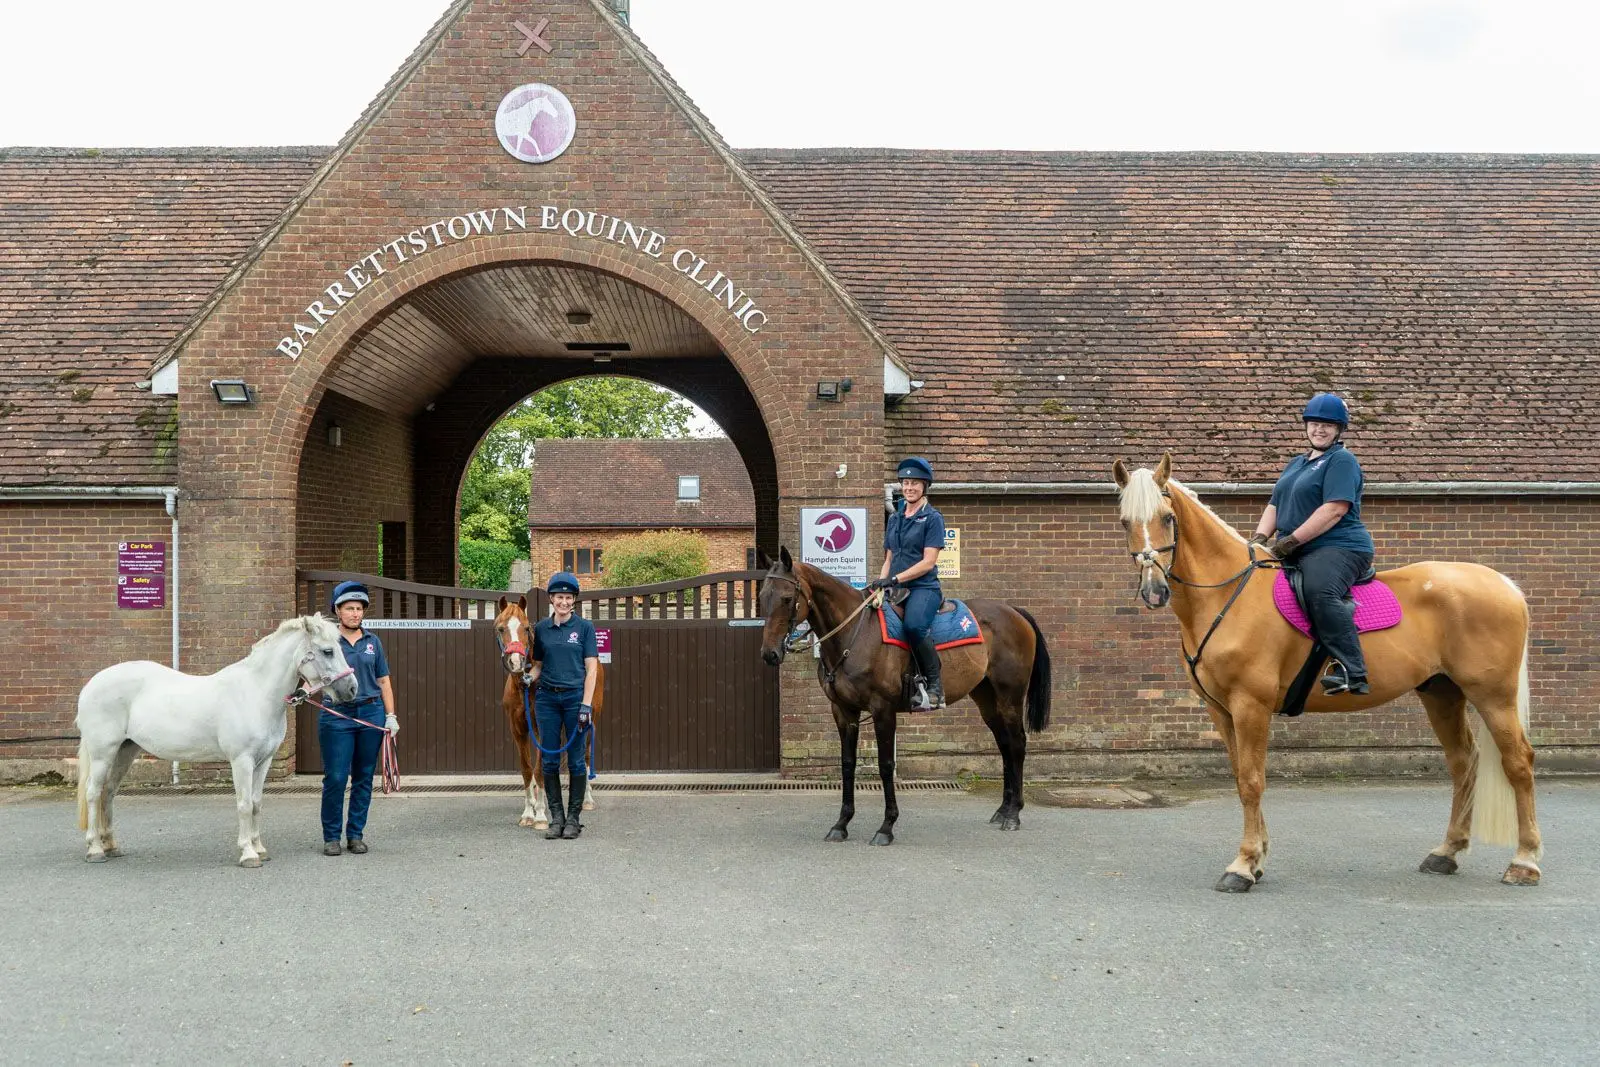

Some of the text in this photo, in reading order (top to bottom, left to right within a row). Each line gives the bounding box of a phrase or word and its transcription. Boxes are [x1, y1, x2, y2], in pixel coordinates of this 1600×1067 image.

[275, 205, 769, 362] BARRETTSTOWN EQUINE CLINIC
[804, 556, 864, 564] Hampden Equine
